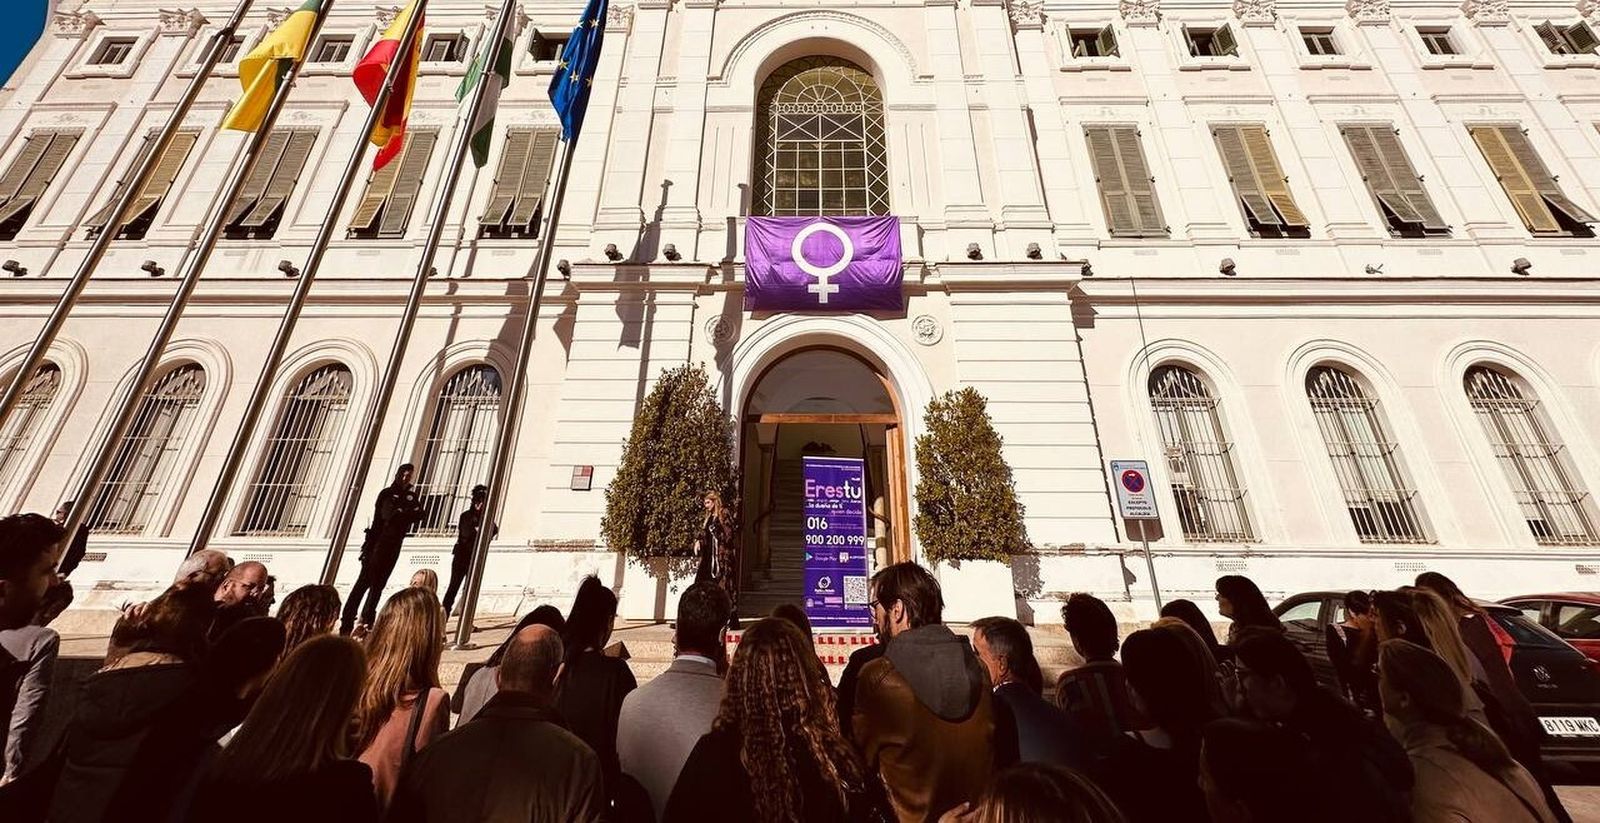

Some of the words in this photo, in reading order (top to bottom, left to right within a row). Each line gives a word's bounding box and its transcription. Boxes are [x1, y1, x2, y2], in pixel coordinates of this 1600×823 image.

[807, 516, 828, 530] 016
[805, 534, 824, 545] 900
[826, 534, 845, 545] 200
[847, 535, 865, 546] 999
[1544, 719, 1575, 732] 8119
[1573, 719, 1599, 732] MKC
